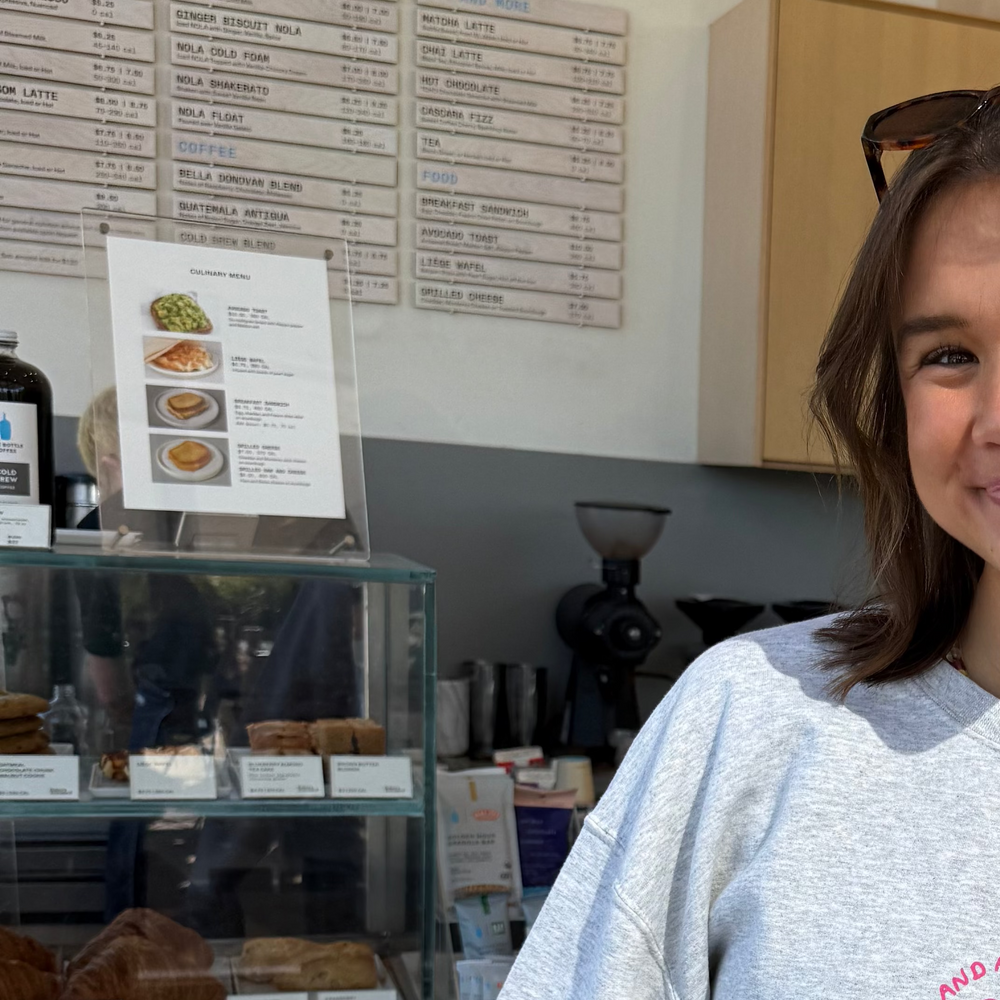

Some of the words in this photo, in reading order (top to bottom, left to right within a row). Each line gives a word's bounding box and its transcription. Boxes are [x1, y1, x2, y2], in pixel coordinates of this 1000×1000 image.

[496, 0, 530, 13] MORE
[176, 10, 217, 24] GINGER
[223, 17, 269, 31] BISCUIT
[275, 23, 303, 36] NOLA
[422, 13, 459, 27] MATCHA
[465, 20, 495, 34] LATTE
[176, 42, 204, 55] NOLA
[210, 47, 238, 60] COLD
[244, 52, 270, 63] FOAM
[422, 45, 446, 57] CHAI
[452, 50, 483, 62] LATTE
[176, 75, 204, 87] NOLA
[209, 80, 270, 96] SHAKERATO
[421, 75, 439, 86] HOT
[445, 79, 500, 95] CHOCOLATE
[23, 88, 59, 101] LATTE
[178, 107, 205, 119] NOLA
[212, 111, 244, 124] FLOAT
[421, 106, 464, 120] CASCARA
[470, 113, 494, 125] FIZZ
[178, 141, 237, 159] COFFEE
[421, 137, 441, 148] TEA
[179, 169, 213, 182] BELLA
[218, 174, 265, 188] DONOVAN
[270, 180, 303, 193] BLEND
[421, 170, 458, 185] FOOD
[179, 202, 239, 217] GUATEMALA
[244, 209, 290, 222] ANTIGUA
[421, 197, 475, 212] BREAKFAST
[481, 204, 529, 219] SANDWICH
[181, 232, 207, 243] COLD
[212, 236, 239, 247] BREW
[243, 239, 276, 251] BLEND
[421, 227, 464, 241] AVOCADO
[470, 232, 499, 244] TOAST
[190, 268, 227, 278] CULINARY
[229, 273, 251, 281] MENU
[456, 260, 487, 273] WAFEL
[421, 287, 464, 300] GRILLED
[2, 442, 24, 450] BOTTLE
[0, 468, 17, 476] OLD
[0, 476, 18, 484] REW
